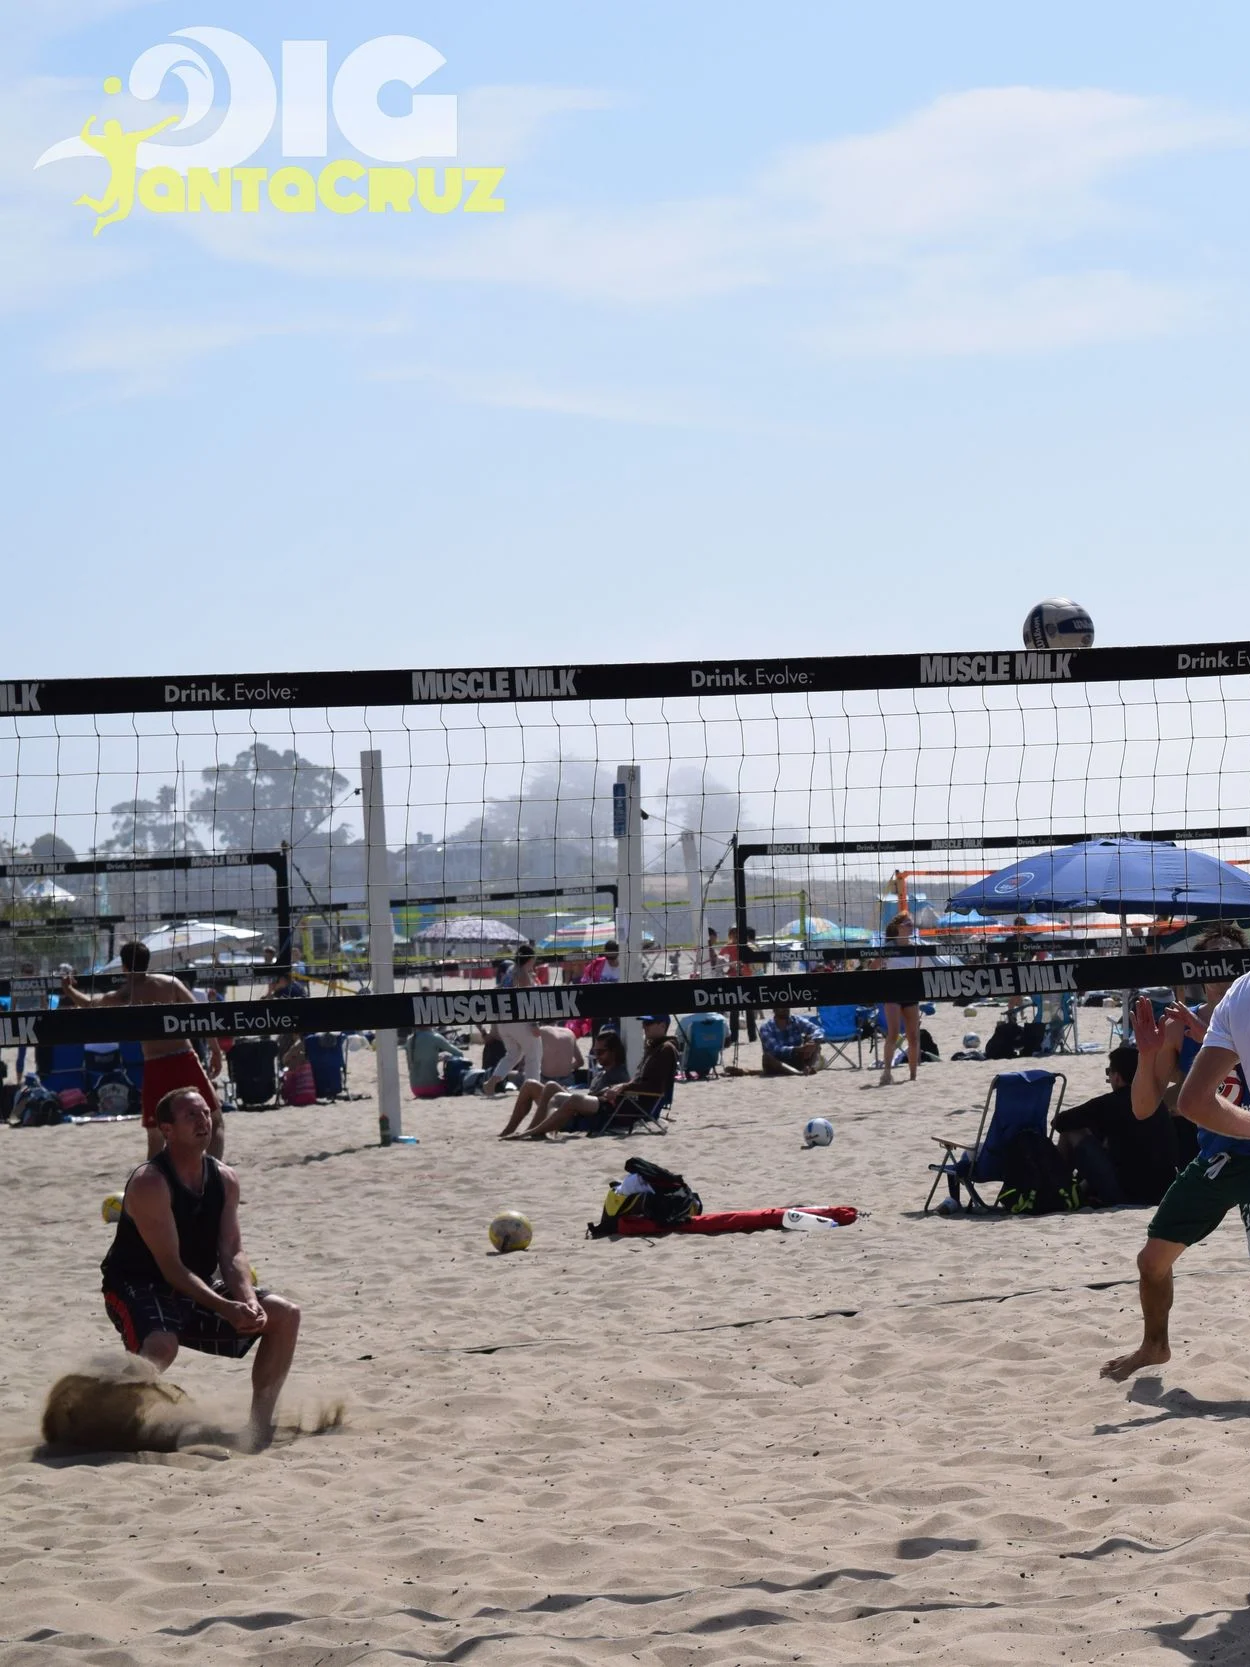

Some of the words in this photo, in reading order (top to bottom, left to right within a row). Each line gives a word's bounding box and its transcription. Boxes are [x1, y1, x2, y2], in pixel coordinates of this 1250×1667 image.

[920, 655, 1011, 684] MUSCLE
[1015, 652, 1072, 681] MILK
[1177, 651, 1233, 670] Drink.
[411, 671, 510, 701] MUSCLE
[515, 668, 578, 698] MILK
[691, 668, 753, 688] Drink.
[756, 665, 813, 686] Evolve.
[164, 682, 231, 703] Drink.
[235, 680, 296, 701] Evolve.
[767, 844, 799, 855] MUSCLE
[799, 843, 820, 854] MILK
[931, 839, 963, 850] MUSCLE
[963, 838, 983, 849] MILK
[771, 952, 802, 962] MUSCLE
[803, 950, 824, 961] MILK
[1181, 958, 1239, 979] Drink.
[922, 967, 1014, 998] MUSCLE
[1018, 964, 1077, 992] MILK
[692, 986, 757, 1007] Drink.
[759, 983, 816, 1004] Evolve.
[412, 994, 512, 1025] MUSCLE
[515, 991, 580, 1019] MILK
[164, 1012, 231, 1034] Drink.
[234, 1009, 297, 1030] Evolve.
